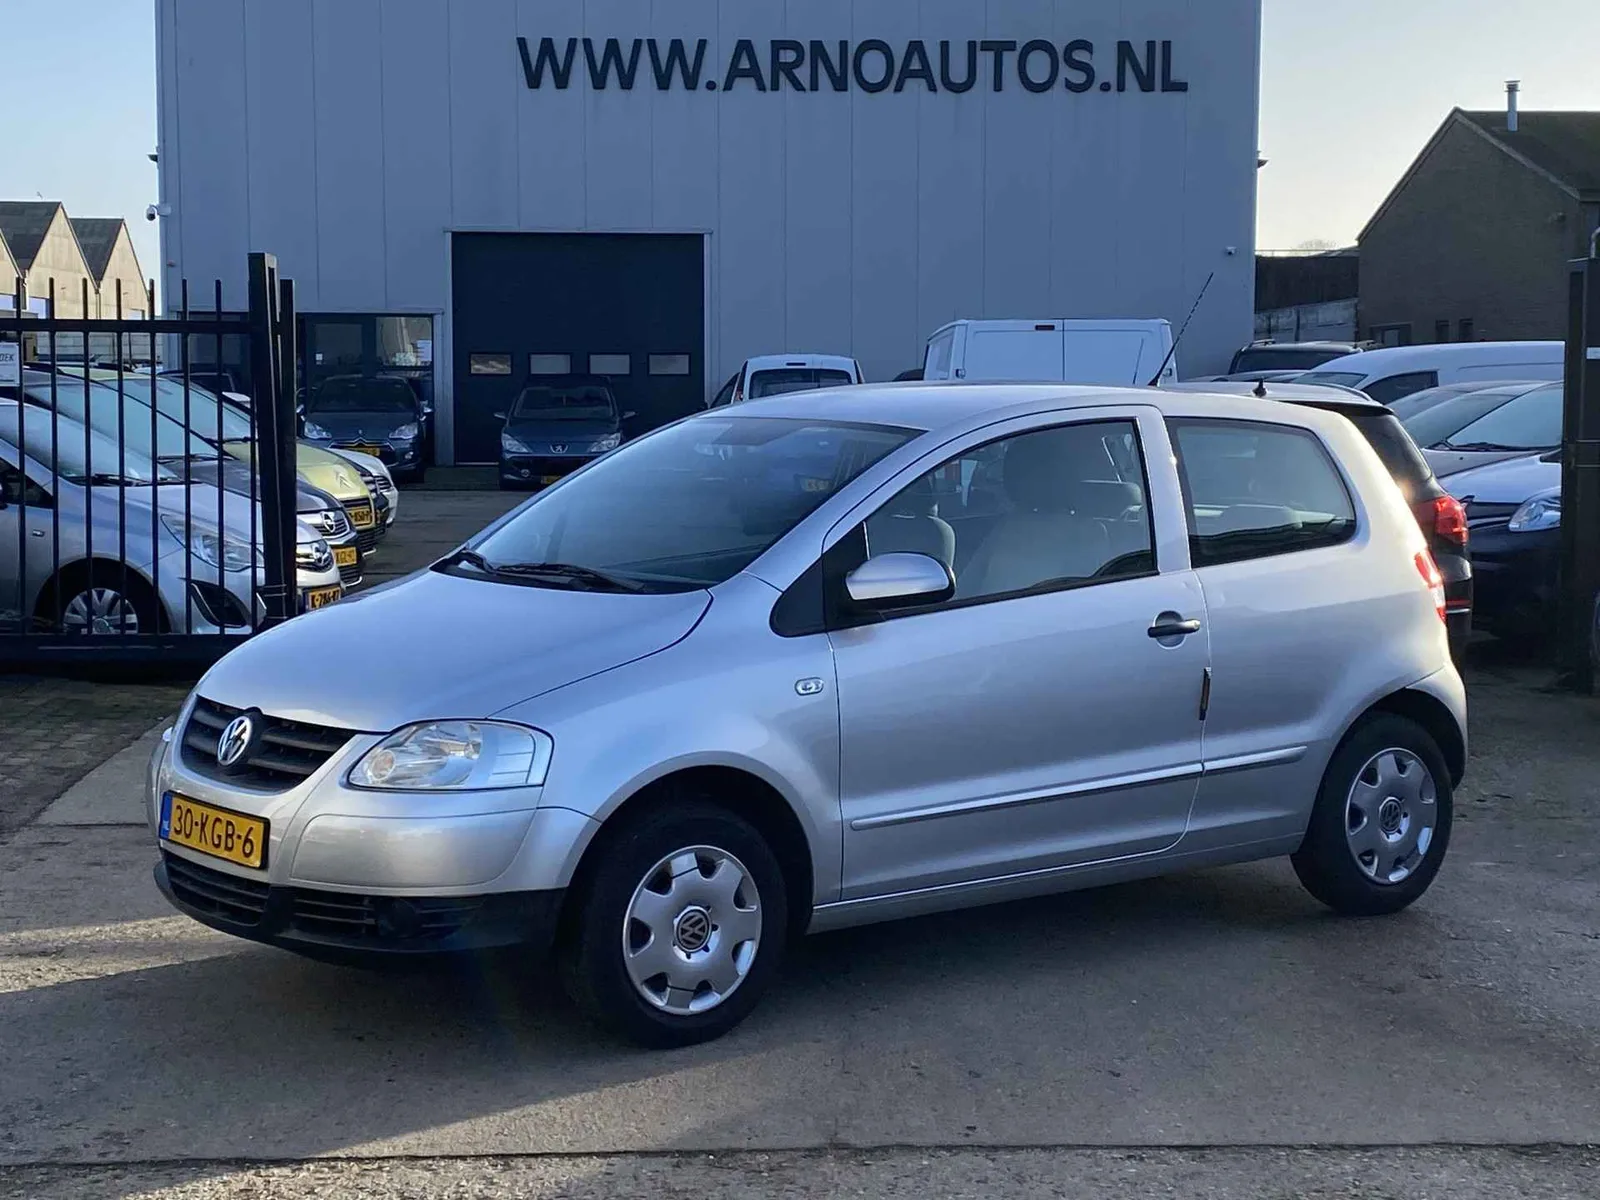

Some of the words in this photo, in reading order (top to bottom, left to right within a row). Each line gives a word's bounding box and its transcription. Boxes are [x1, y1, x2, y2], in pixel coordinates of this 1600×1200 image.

[516, 37, 1189, 93] WWW.ARNOAUTOS.NL
[173, 804, 255, 858] 30-KGB-6
[678, 909, 709, 950] VW
